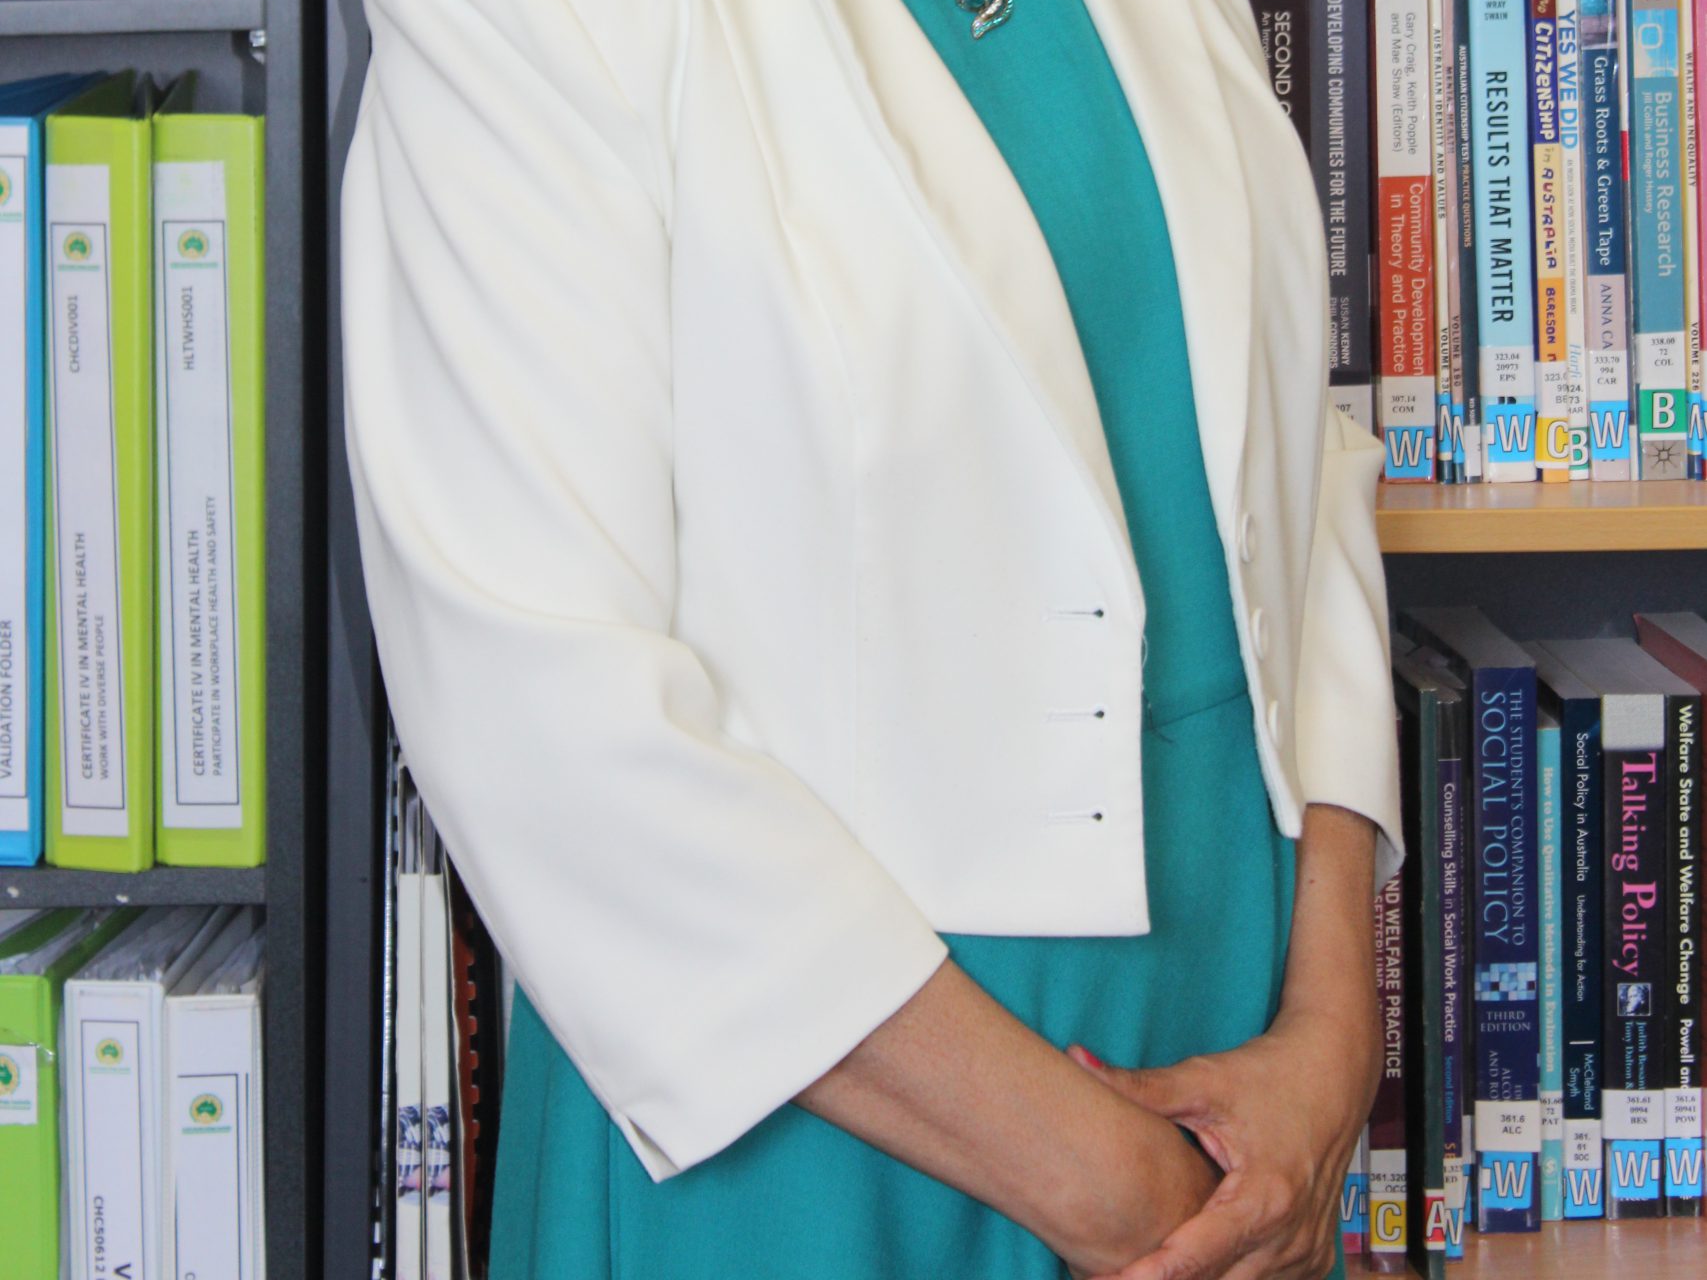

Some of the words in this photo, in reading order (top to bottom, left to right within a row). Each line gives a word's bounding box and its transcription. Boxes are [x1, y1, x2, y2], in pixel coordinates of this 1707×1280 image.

[1274, 11, 1291, 95] SECOND
[1558, 10, 1576, 56] YES
[1392, 69, 1402, 99] Shaw
[1559, 61, 1577, 105] WE
[1594, 57, 1608, 103] Grass
[1327, 79, 1346, 168] COMMUNITIES
[1485, 70, 1512, 168] RESULTS
[1559, 108, 1578, 150] DID
[1595, 107, 1612, 156] Roots
[1654, 90, 1673, 181] Business
[1329, 171, 1345, 195] FOR
[1390, 194, 1404, 208] in
[1488, 179, 1512, 228] THAT
[1597, 175, 1612, 223] Green
[1329, 200, 1345, 223] THE
[1408, 183, 1425, 273] Community
[1656, 185, 1675, 277] Research
[1329, 227, 1346, 277] FUTURE
[1388, 214, 1406, 268] Theory
[1596, 227, 1613, 266] Tape
[1391, 274, 1406, 303] and
[1490, 238, 1514, 323] MATTER
[67, 295, 80, 373] CHCDIV001
[181, 286, 194, 370] HLTWHS001
[1341, 333, 1350, 366] KENNY
[1391, 310, 1407, 373] Practice
[1409, 278, 1426, 376] Developmen
[1691, 322, 1700, 364] VOLUME
[1496, 415, 1531, 452] W
[1590, 412, 1626, 448] W
[1652, 392, 1675, 429] B
[1388, 429, 1424, 467] W
[205, 496, 217, 537] SAFETY
[74, 532, 86, 587] HEALTH
[187, 530, 200, 584] HEALTH
[206, 540, 216, 564] AND
[207, 568, 218, 612] HEALTH
[77, 592, 89, 651] MENTAL
[94, 615, 104, 657] PEOPLE
[189, 589, 201, 647] MENTAL
[0, 620, 12, 678] FOLDER
[79, 656, 89, 670] IN
[191, 652, 202, 667] IN
[208, 616, 220, 685] WORKPLACE
[80, 675, 91, 689] IV
[96, 660, 106, 707] DIVERSE
[191, 671, 202, 685] IV
[210, 689, 220, 701] IN
[98, 710, 107, 740] WITH
[1509, 689, 1522, 722] THE
[0, 684, 13, 778] VALIDATION
[79, 692, 93, 780] CERTIFICATE
[191, 690, 205, 776] CERTIFICATE
[210, 704, 223, 776] PARTICIPATE
[1481, 690, 1506, 811] SOCIAL
[1576, 733, 1588, 770] Social
[1678, 704, 1693, 774] Welfare
[98, 744, 109, 780] WORK
[1510, 725, 1523, 811] STUDENT'S
[1574, 774, 1588, 810] Policy
[1611, 752, 1657, 872] Talking
[1679, 778, 1693, 822] State
[1442, 782, 1456, 859] Counselling
[1576, 813, 1588, 824] in
[1576, 828, 1589, 882] Australia
[1679, 826, 1693, 861] and
[1443, 863, 1456, 895] Skills
[1482, 824, 1508, 945] POLICY
[1510, 815, 1524, 919] COMPANION
[1444, 899, 1455, 910] in
[1679, 865, 1693, 934] Welfare
[1385, 909, 1400, 990] WELFARE
[1444, 913, 1456, 950] Social
[1512, 923, 1525, 946] TO
[1574, 895, 1587, 958] Understanding
[1612, 880, 1657, 976] Policy
[1444, 954, 1456, 989] Work
[1576, 974, 1586, 1001] Action
[1577, 959, 1586, 971] for
[1676, 938, 1696, 1005] Change
[1385, 995, 1400, 1079] PRACTICE
[1444, 994, 1455, 1042] Practice
[1480, 1022, 1531, 1032] EDITION
[1485, 1010, 1526, 1020] THIRD
[1679, 1019, 1695, 1063] Powell
[1568, 1067, 1580, 1097] Smyth
[1583, 1053, 1594, 1110] McClelland
[1493, 1161, 1529, 1198] W
[1568, 1169, 1601, 1205] W
[1615, 1151, 1649, 1187] W
[93, 1196, 104, 1272] CHC50612
